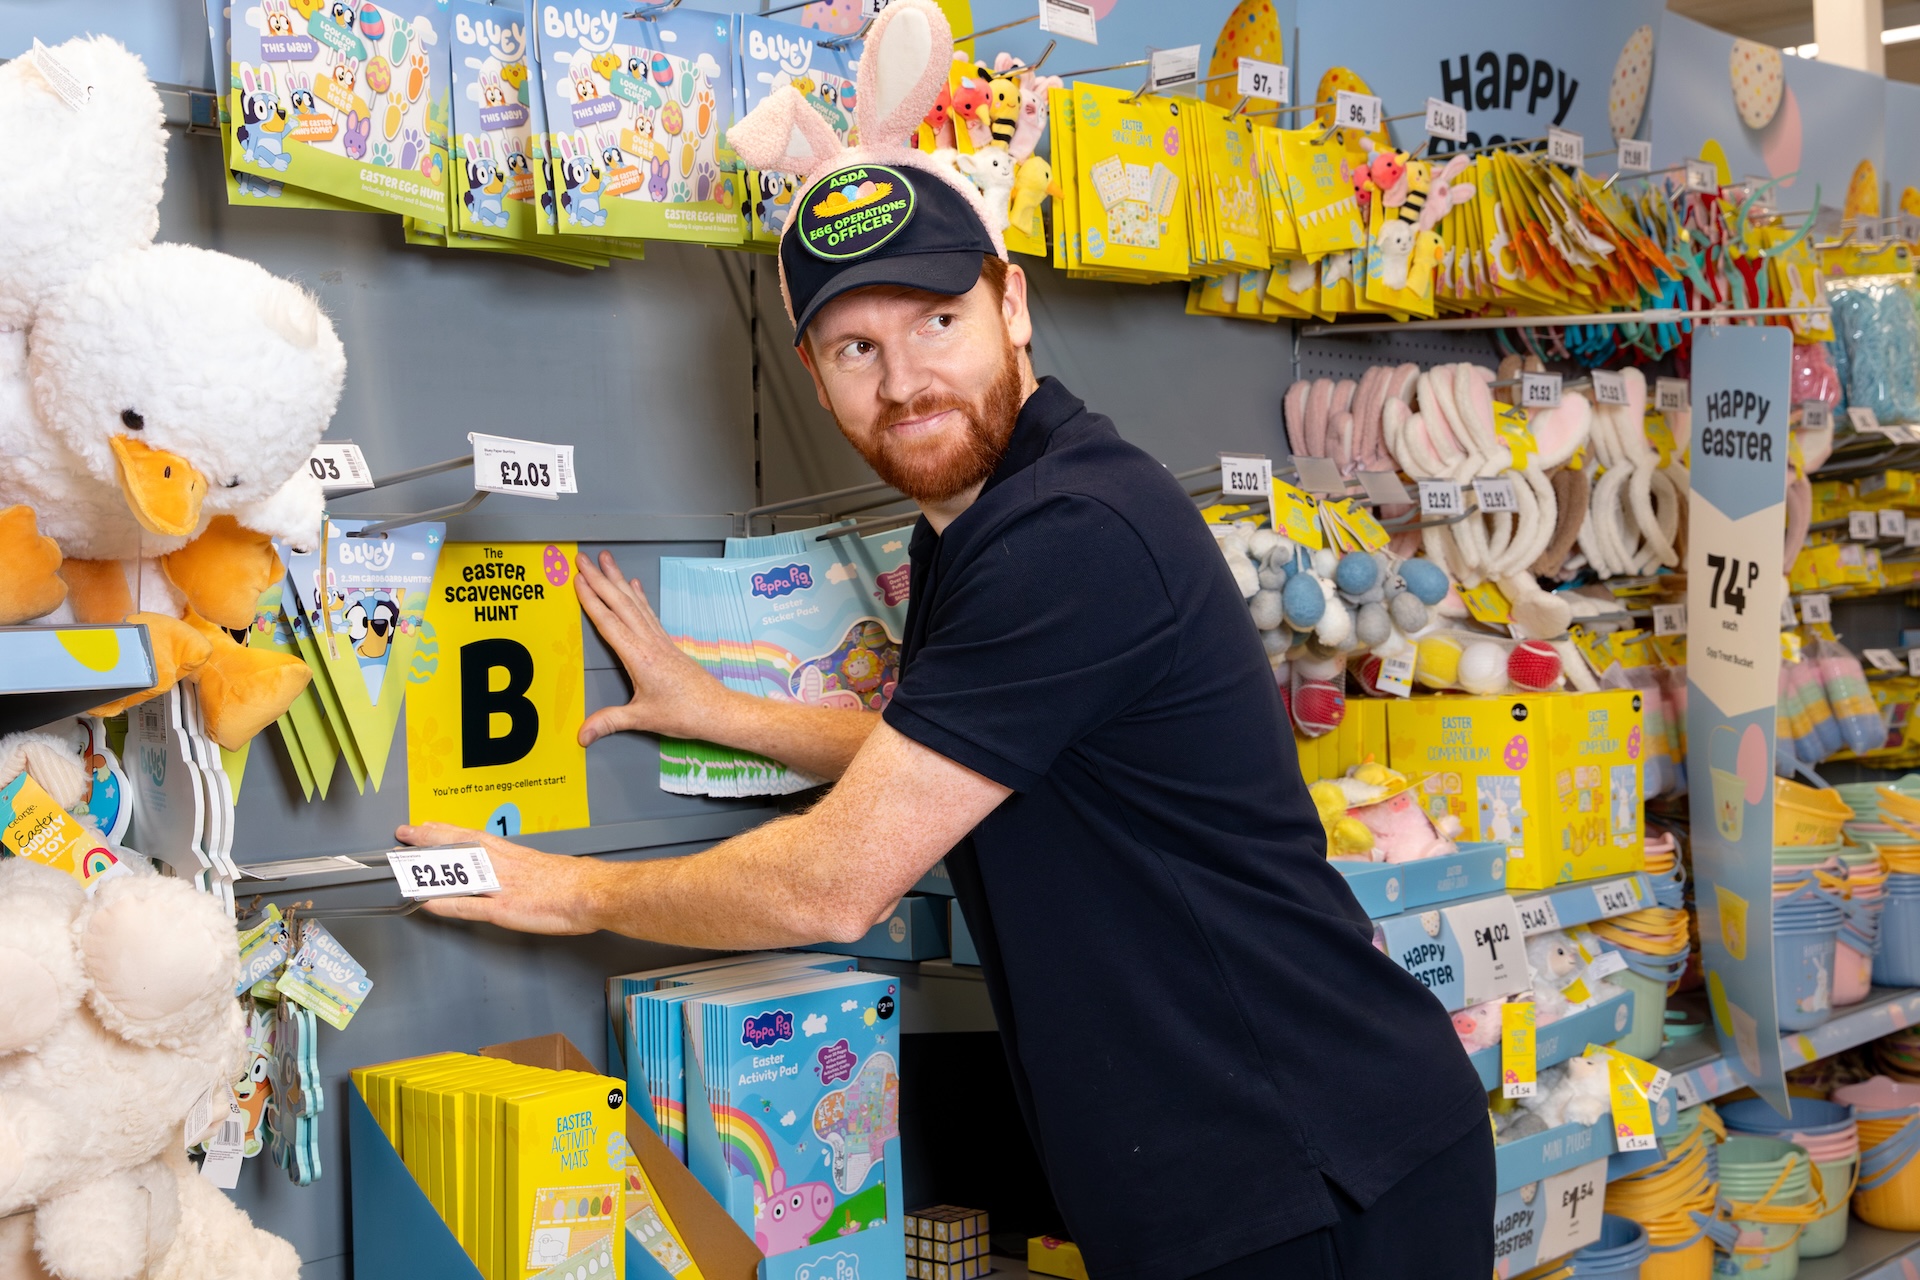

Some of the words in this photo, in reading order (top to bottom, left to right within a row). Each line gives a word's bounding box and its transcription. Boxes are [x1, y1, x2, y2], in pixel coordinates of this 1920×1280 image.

[544, 6, 617, 53] BLUEY
[750, 30, 812, 75] BLUEY
[399, 180, 419, 195] EGG
[829, 169, 868, 189] ASDA
[698, 210, 715, 222] EGG
[809, 222, 833, 242] EGG
[834, 199, 907, 230] OPERATIONS
[827, 213, 893, 247] OFFICER
[501, 461, 551, 487] £2.03
[1231, 471, 1259, 491] £3.02
[339, 541, 396, 572] BLUEY
[483, 548, 503, 559] The
[754, 574, 790, 596] Peppa
[789, 567, 811, 586] Pig
[474, 605, 519, 622] HUNT
[762, 611, 795, 626] Sticker
[796, 605, 819, 618] Pack
[773, 599, 804, 612] Easter
[460, 637, 539, 769] B
[1442, 717, 1472, 729] EASTER
[1441, 730, 1473, 745] GAMES
[1427, 746, 1490, 762] COMPENDIUM
[433, 787, 459, 797] You're
[460, 785, 473, 794] off
[474, 785, 484, 793] to
[496, 778, 542, 792] egg-cellent
[543, 776, 566, 785] start!
[14, 812, 54, 848] Easter
[20, 814, 66, 857] CUDDLY
[497, 816, 508, 837] 1
[37, 832, 66, 858] TOY
[411, 862, 469, 888] £2.56
[317, 954, 354, 984] BLUEY
[746, 1020, 775, 1043] Peppa
[776, 1015, 791, 1037] Pig
[753, 1054, 785, 1069] Easter
[738, 1069, 778, 1087] Activity
[780, 1063, 798, 1077] Pad
[608, 1092, 622, 1105] 97p
[557, 1110, 592, 1133] EASTER
[551, 1126, 598, 1154] ACTIVITY
[561, 1148, 589, 1172] MATS
